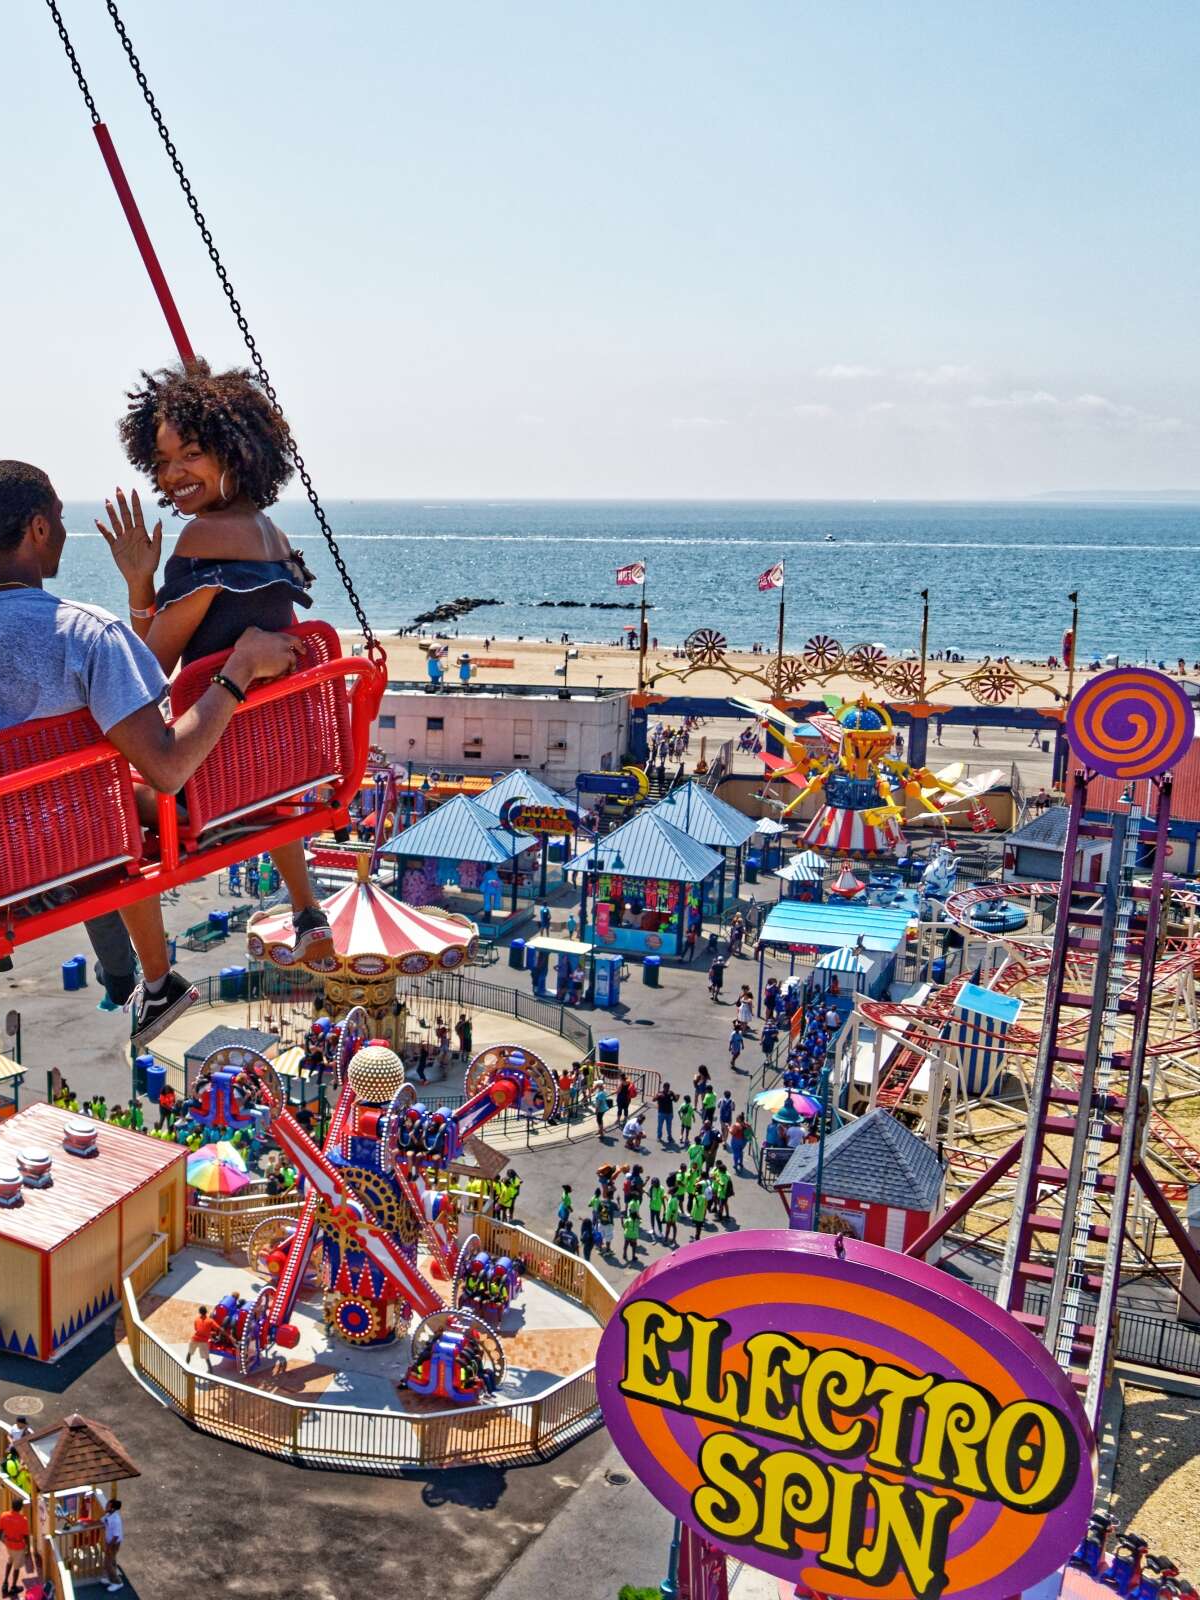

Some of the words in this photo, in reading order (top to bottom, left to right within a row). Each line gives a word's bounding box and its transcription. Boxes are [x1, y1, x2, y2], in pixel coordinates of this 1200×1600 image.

[521, 805, 568, 820] LUNA
[621, 1300, 1070, 1508] ELECTRO
[693, 1432, 950, 1594] SPIN
